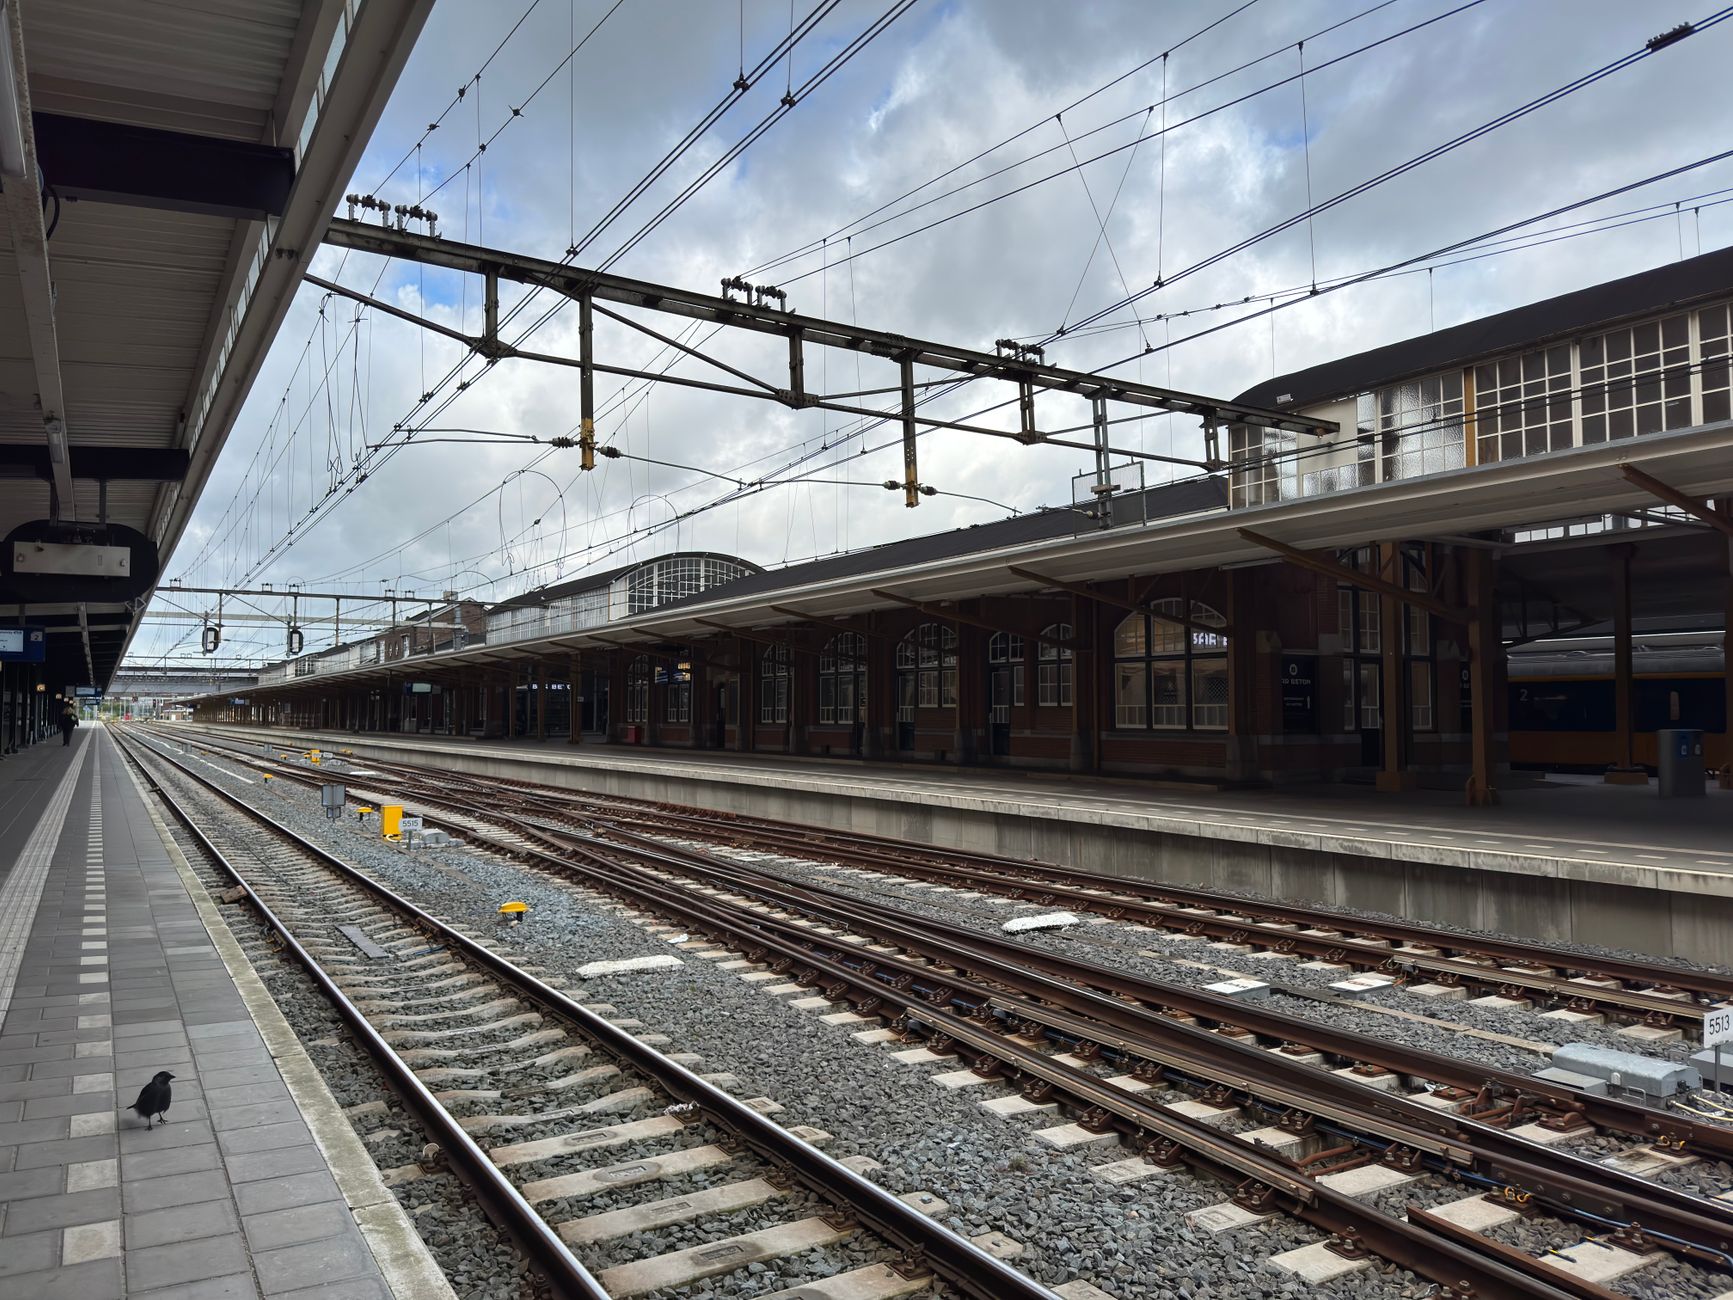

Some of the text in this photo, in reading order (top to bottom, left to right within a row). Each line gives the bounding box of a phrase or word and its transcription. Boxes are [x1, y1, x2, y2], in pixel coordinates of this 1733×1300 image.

[1519, 688, 1528, 702] 2
[402, 819, 419, 828] 5515
[1709, 1014, 1730, 1035] 5513
